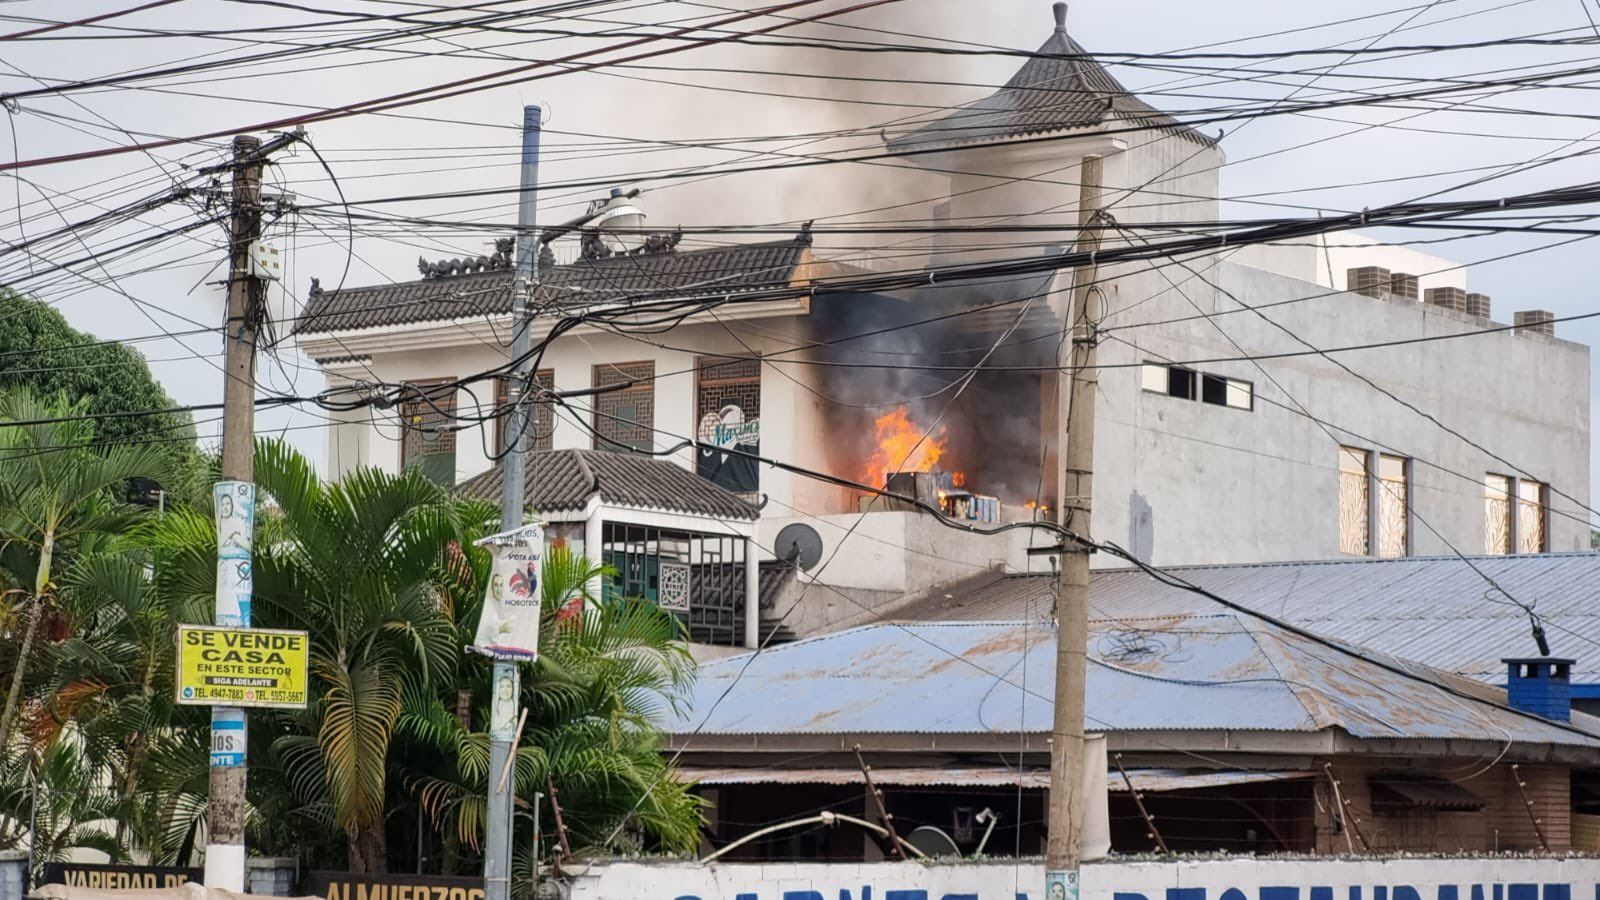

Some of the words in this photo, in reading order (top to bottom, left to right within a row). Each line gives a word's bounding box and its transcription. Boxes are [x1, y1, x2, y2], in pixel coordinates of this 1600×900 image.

[186, 631, 215, 646] SE
[223, 633, 301, 651] VENDE
[201, 649, 285, 664] CASA
[197, 663, 212, 672] EN
[216, 664, 244, 674] ESTE
[248, 665, 292, 676] SECTOR
[213, 677, 231, 685] SIGA
[233, 678, 272, 687] ADELANTE
[194, 687, 208, 698] TEL.
[255, 690, 269, 701] TEL.
[210, 754, 234, 766] NTE
[64, 870, 158, 889] VARIEDAD
[164, 874, 189, 889] DE
